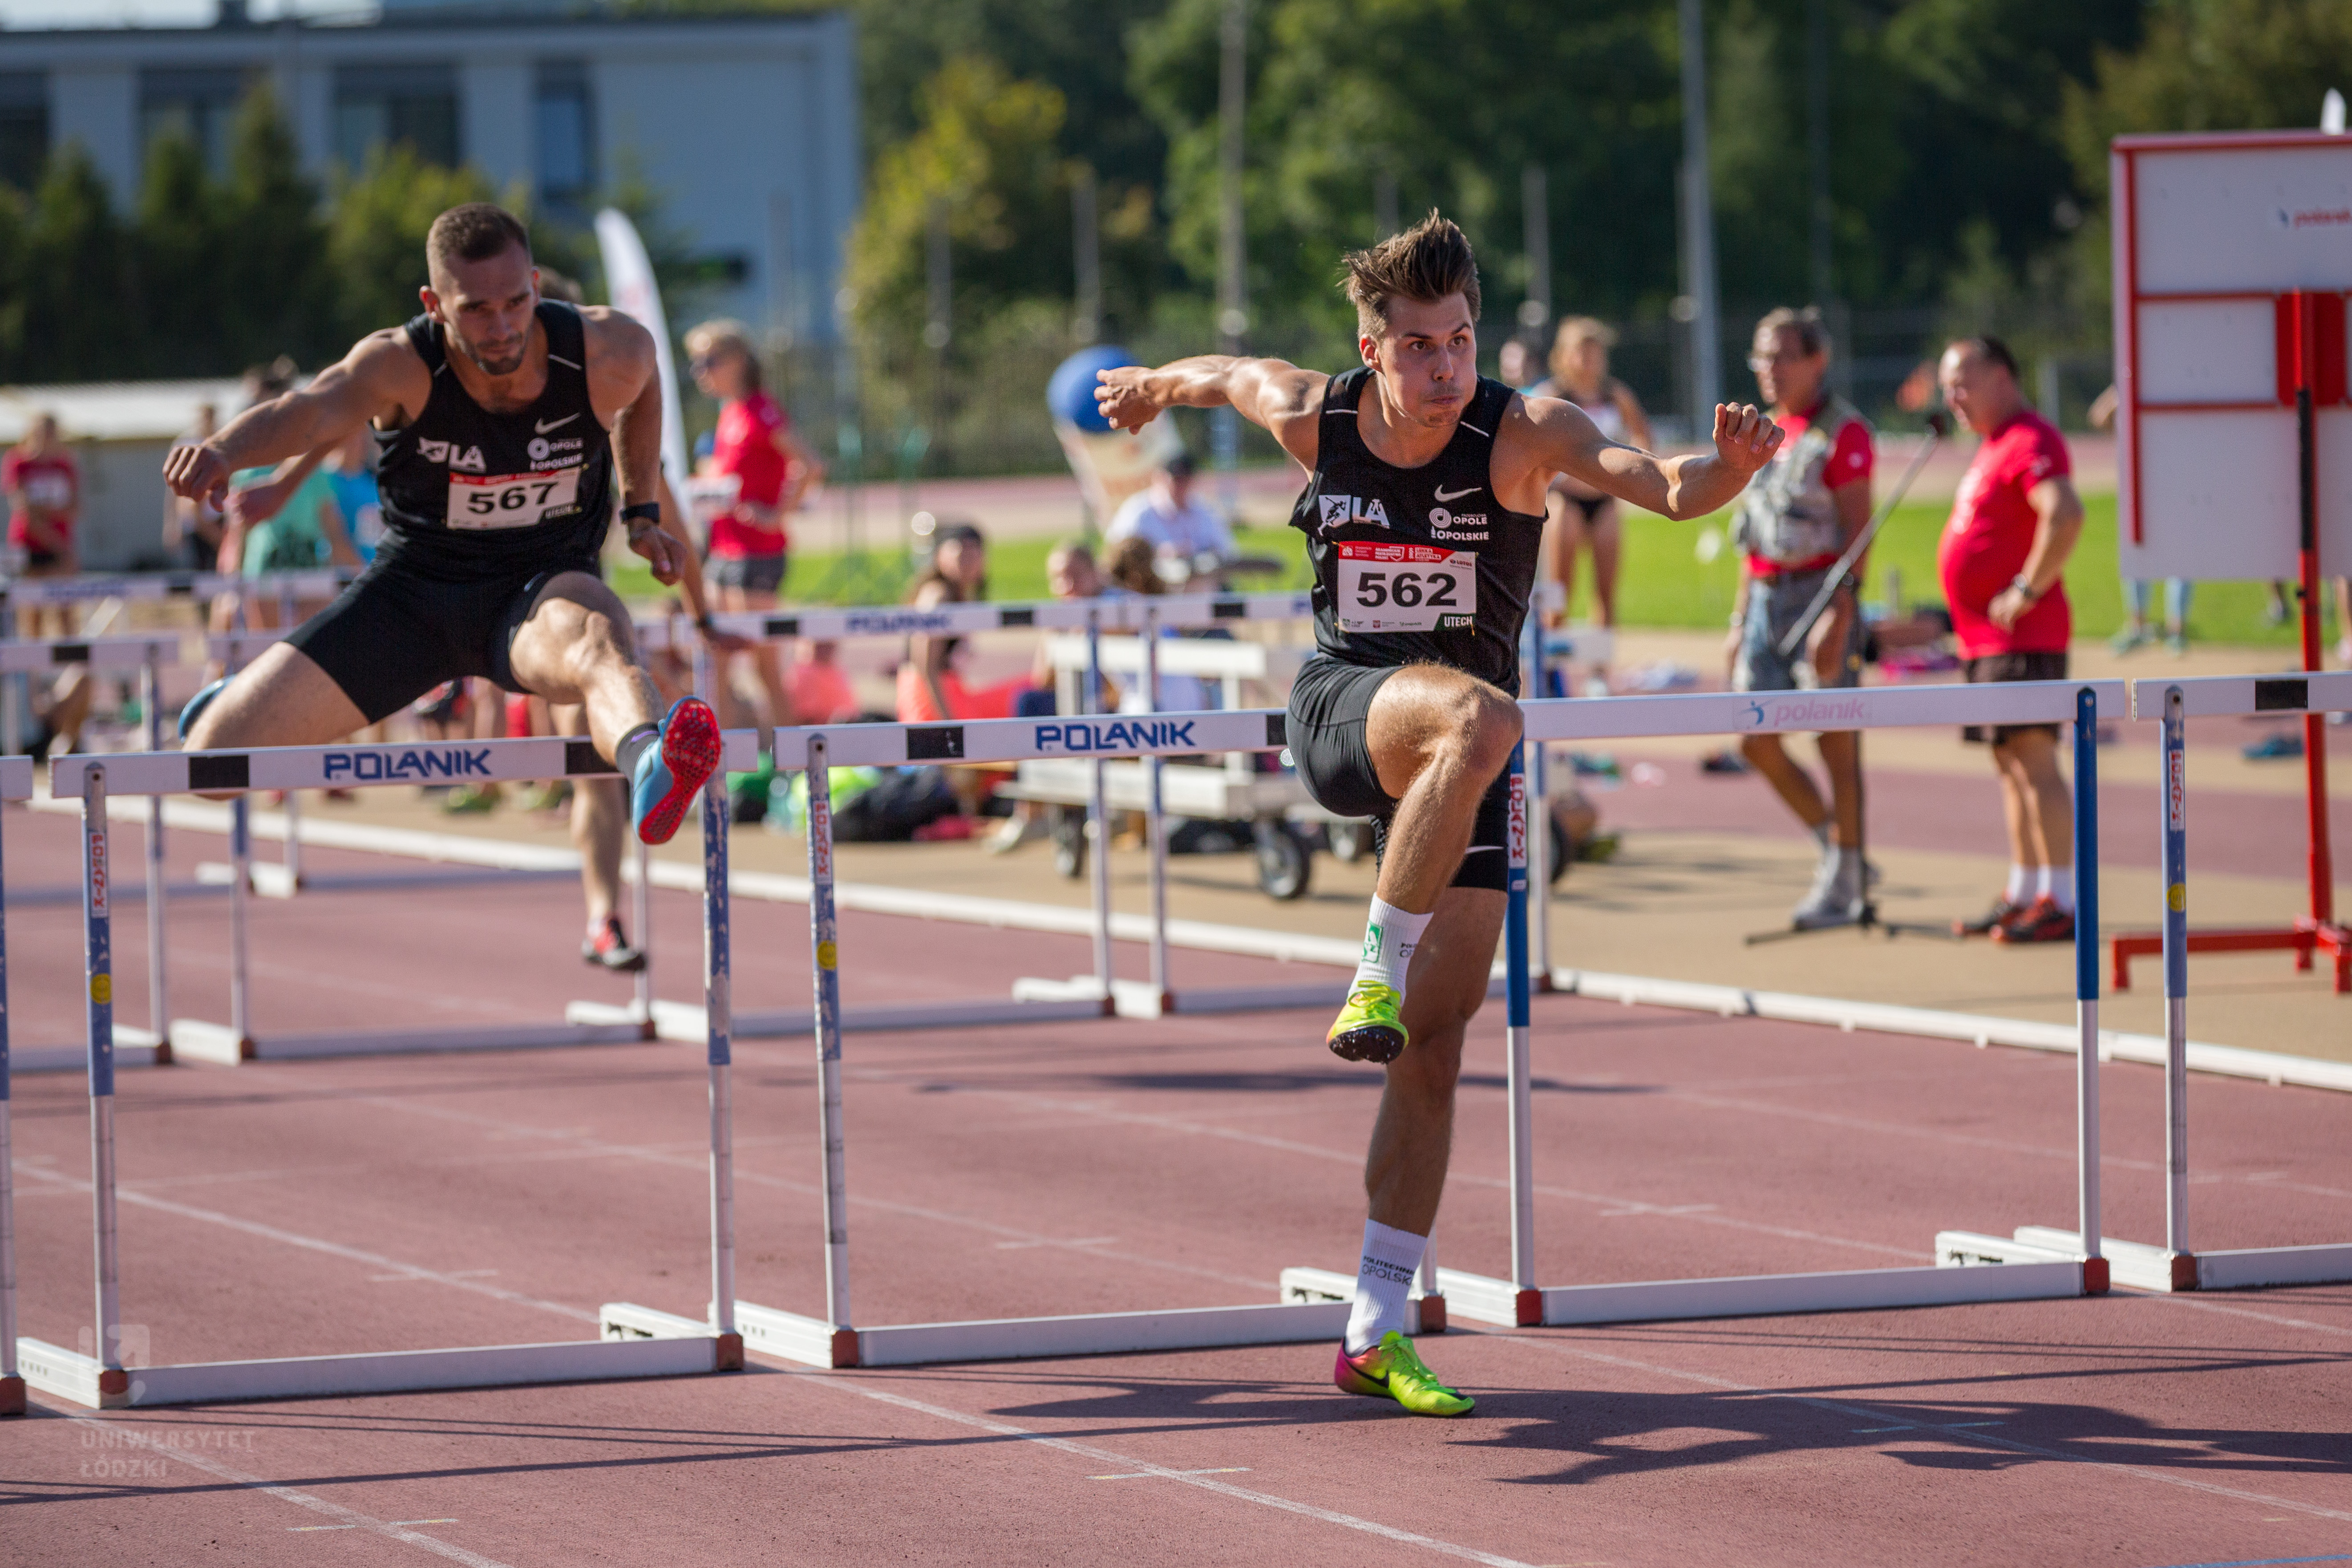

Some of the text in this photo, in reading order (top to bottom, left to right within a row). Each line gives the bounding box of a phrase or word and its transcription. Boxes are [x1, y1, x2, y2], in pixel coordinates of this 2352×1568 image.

[468, 482, 559, 513] 567
[1437, 530, 1489, 541] OPOLSKIE
[1453, 516, 1487, 525] OPOLE
[1356, 572, 1457, 607] 562
[1444, 616, 1473, 627] UTECH
[1773, 697, 1864, 727] polanik
[1036, 721, 1195, 751] POLANIK
[323, 748, 491, 780] POLANIK
